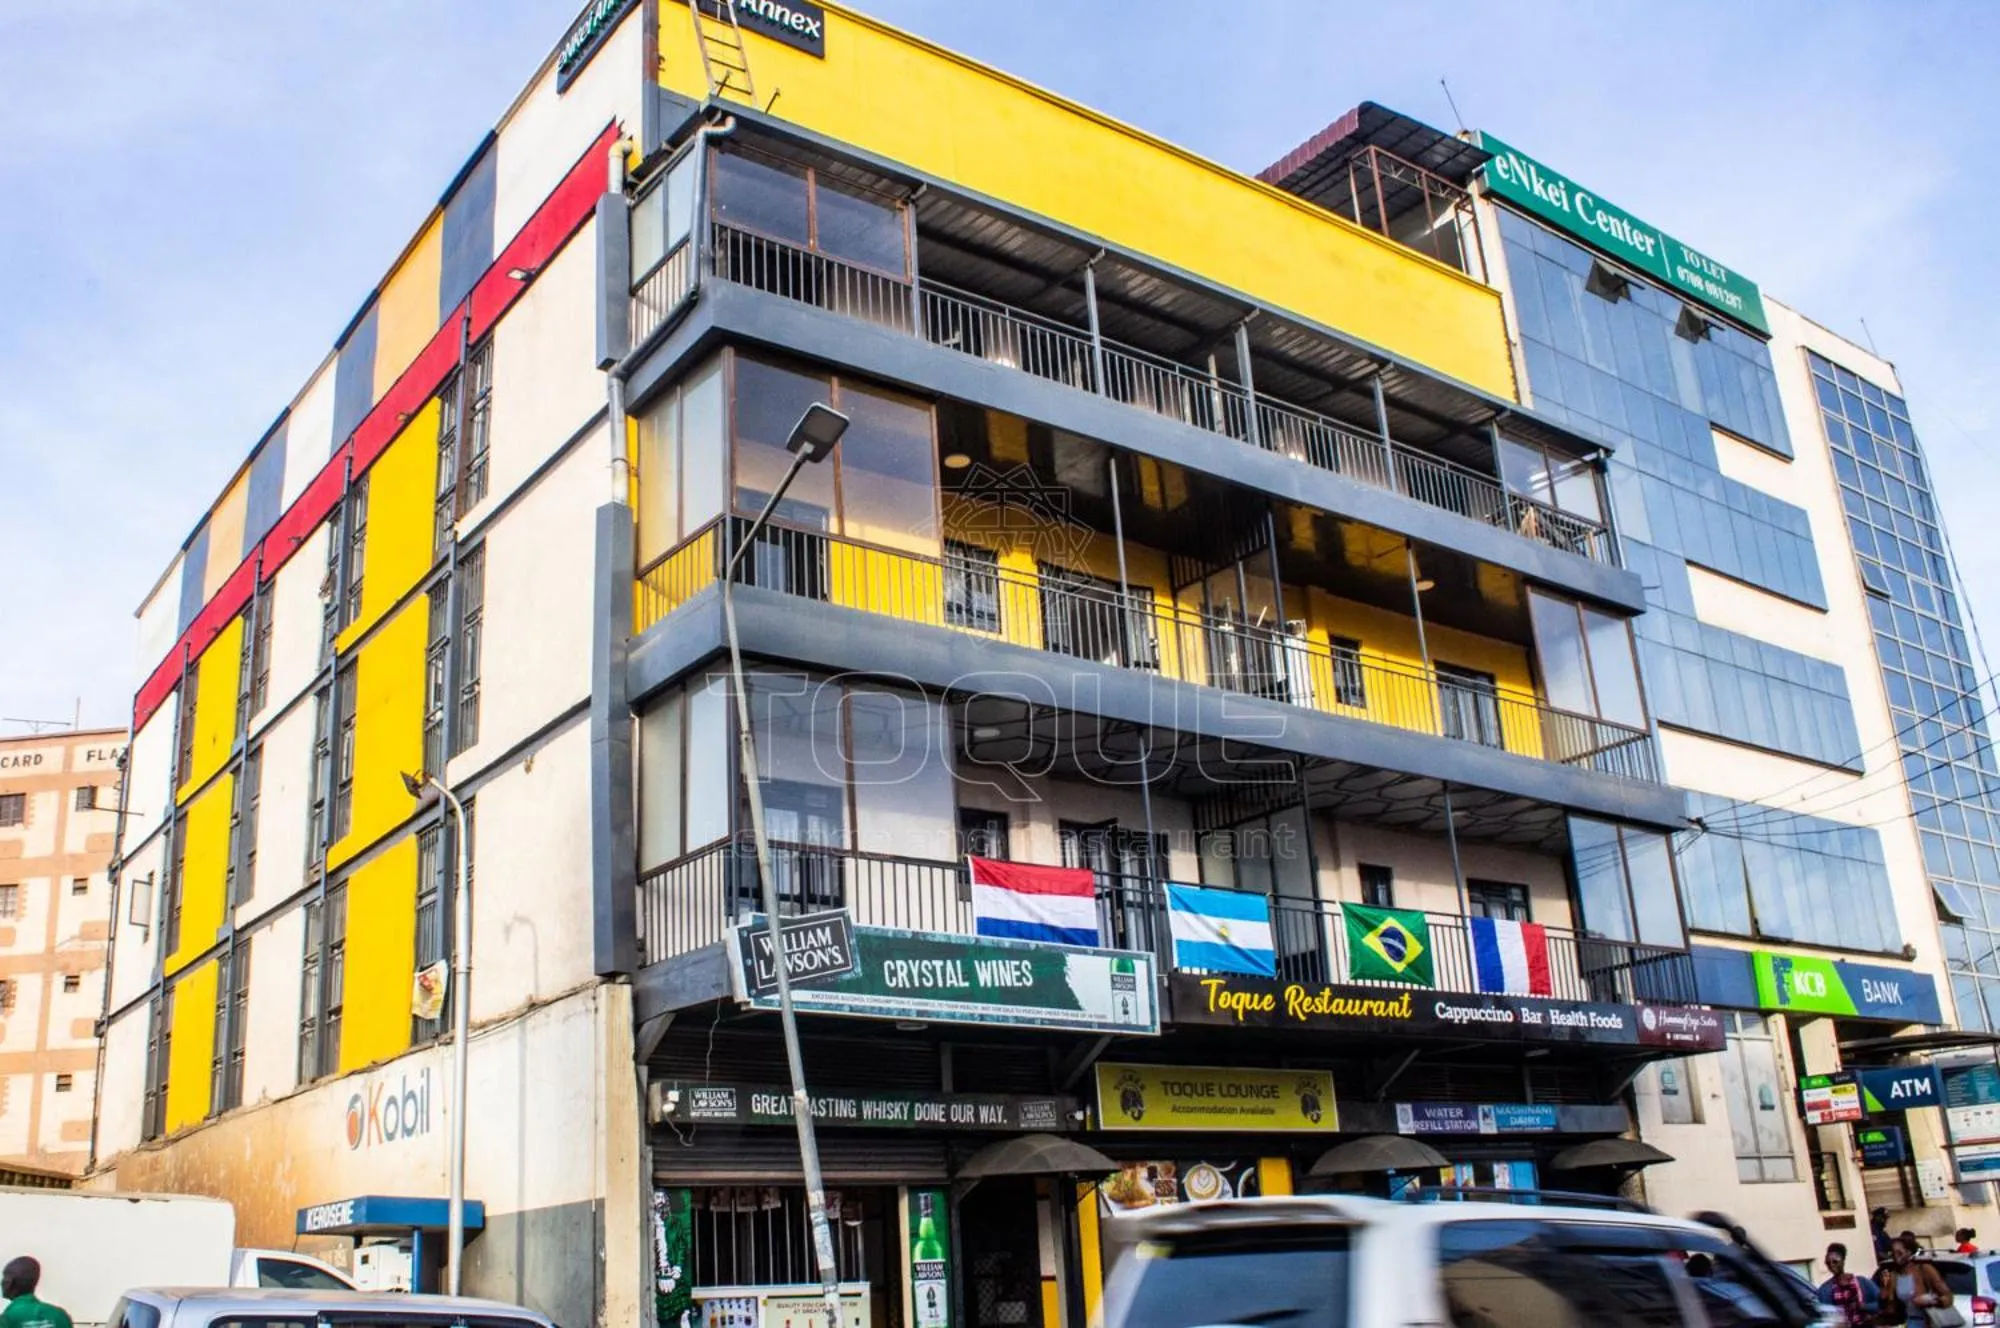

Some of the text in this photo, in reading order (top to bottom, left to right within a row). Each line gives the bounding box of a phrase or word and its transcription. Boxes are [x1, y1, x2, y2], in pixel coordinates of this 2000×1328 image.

[1495, 151, 1656, 258] eNkei Center
[1680, 246, 1727, 283] TO LET
[0, 746, 129, 769] CARD FLA
[883, 959, 1034, 988] CRYSTAL WINES
[1200, 979, 1413, 1021] Toque Restaurant
[1793, 971, 1903, 1005] KCB BANK
[1434, 1002, 1624, 1029] Cappuccino Bar Health Foods
[1160, 1081, 1280, 1100] TOQUE LOUNGE
[1890, 1076, 1932, 1099] ATM
[862, 1100, 910, 1121] WHISKY
[914, 1103, 946, 1122] DONE
[950, 1105, 975, 1122] OUR
[979, 1104, 1007, 1125] WAY.
[1170, 1103, 1238, 1115] Accommodation
[1424, 1107, 1464, 1119] WATER
[1413, 1118, 1478, 1131] REFILL STATION
[916, 1263, 944, 1271] WILLIAM
